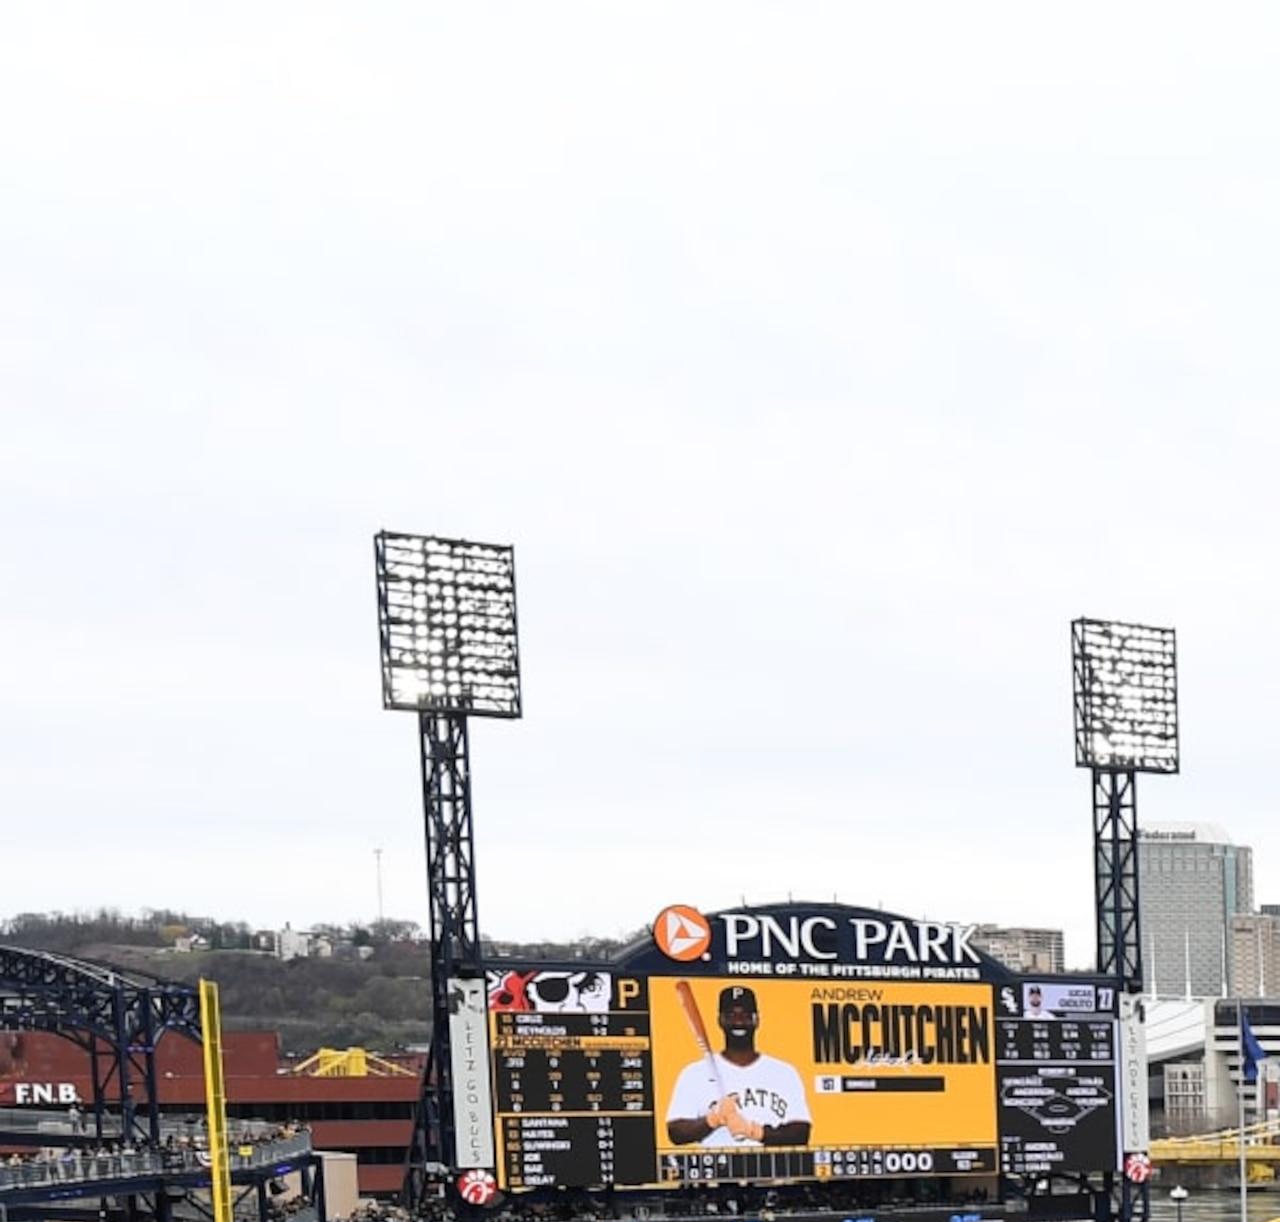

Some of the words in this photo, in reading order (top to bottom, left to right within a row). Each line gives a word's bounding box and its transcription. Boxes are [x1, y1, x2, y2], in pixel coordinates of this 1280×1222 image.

[722, 914, 836, 959] PNC
[850, 918, 981, 963] PARK
[728, 961, 772, 975] HOME
[775, 962, 796, 976] OF
[799, 963, 829, 978] THE
[833, 965, 921, 980] PITTSBURGH
[923, 966, 981, 981] PIRATES
[618, 978, 640, 1008] P
[811, 987, 883, 1001] ANDREW
[812, 1003, 990, 1064] MCCUTCHEN
[15, 1083, 82, 1104] F.N.B.
[703, 1155, 714, 1166] 0
